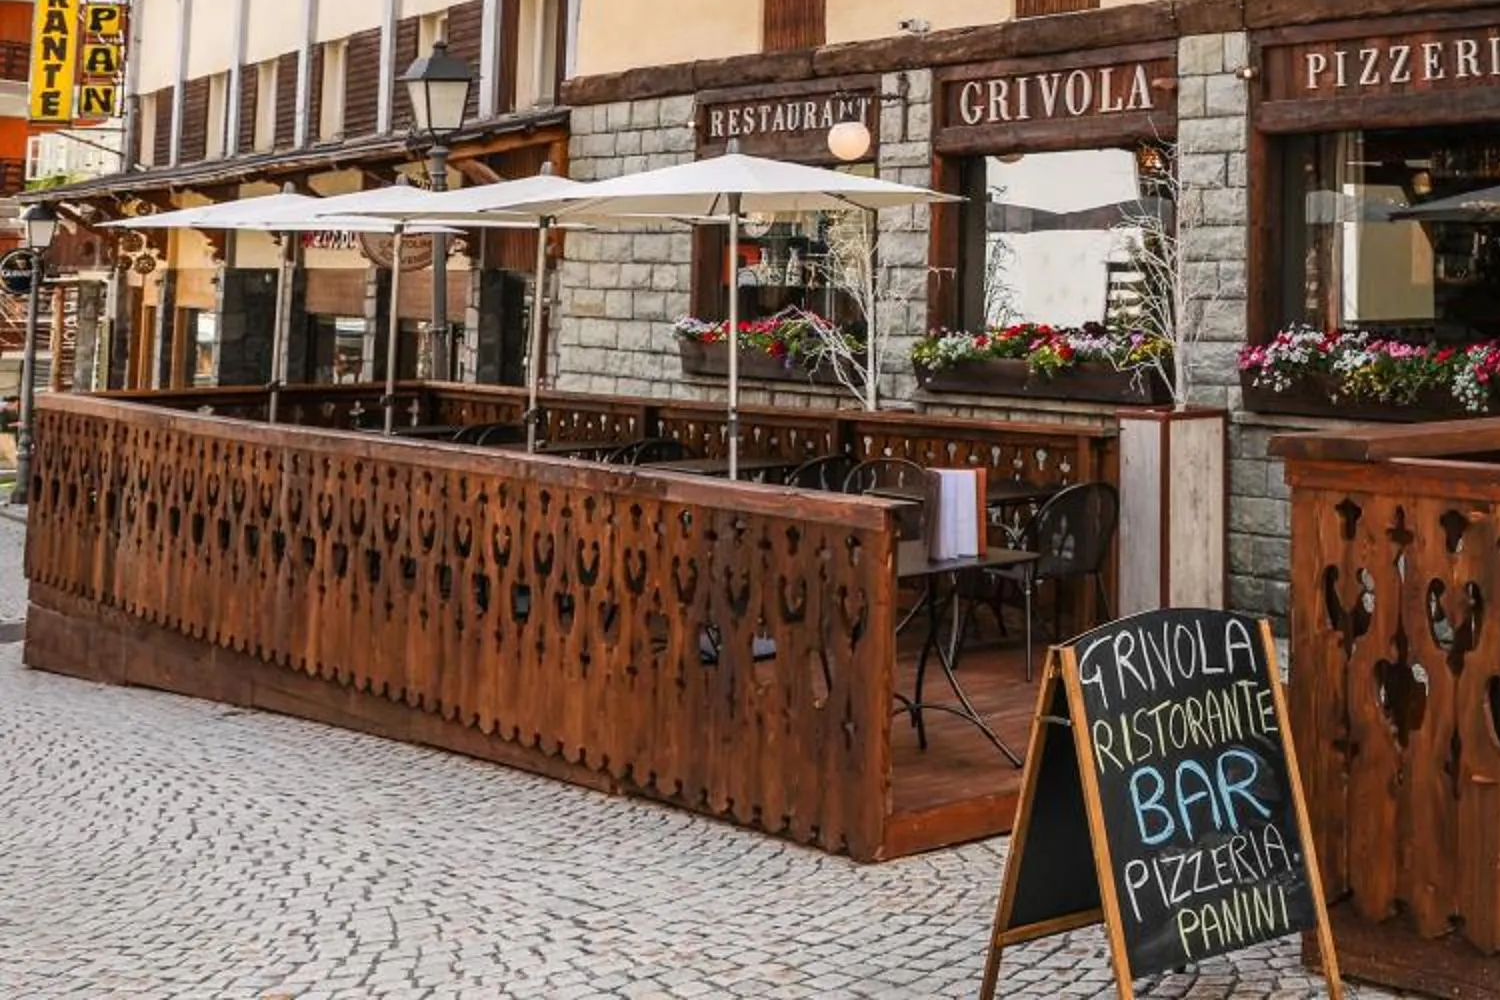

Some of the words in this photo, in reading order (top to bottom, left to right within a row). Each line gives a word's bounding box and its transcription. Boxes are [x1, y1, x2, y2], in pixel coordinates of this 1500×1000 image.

[959, 63, 1154, 126] GRIVOLA
[1079, 618, 1257, 710] GRIVOLA
[1092, 679, 1280, 775] RISTORANTE
[1128, 749, 1272, 846] BAR
[1176, 885, 1290, 963] PANINI
